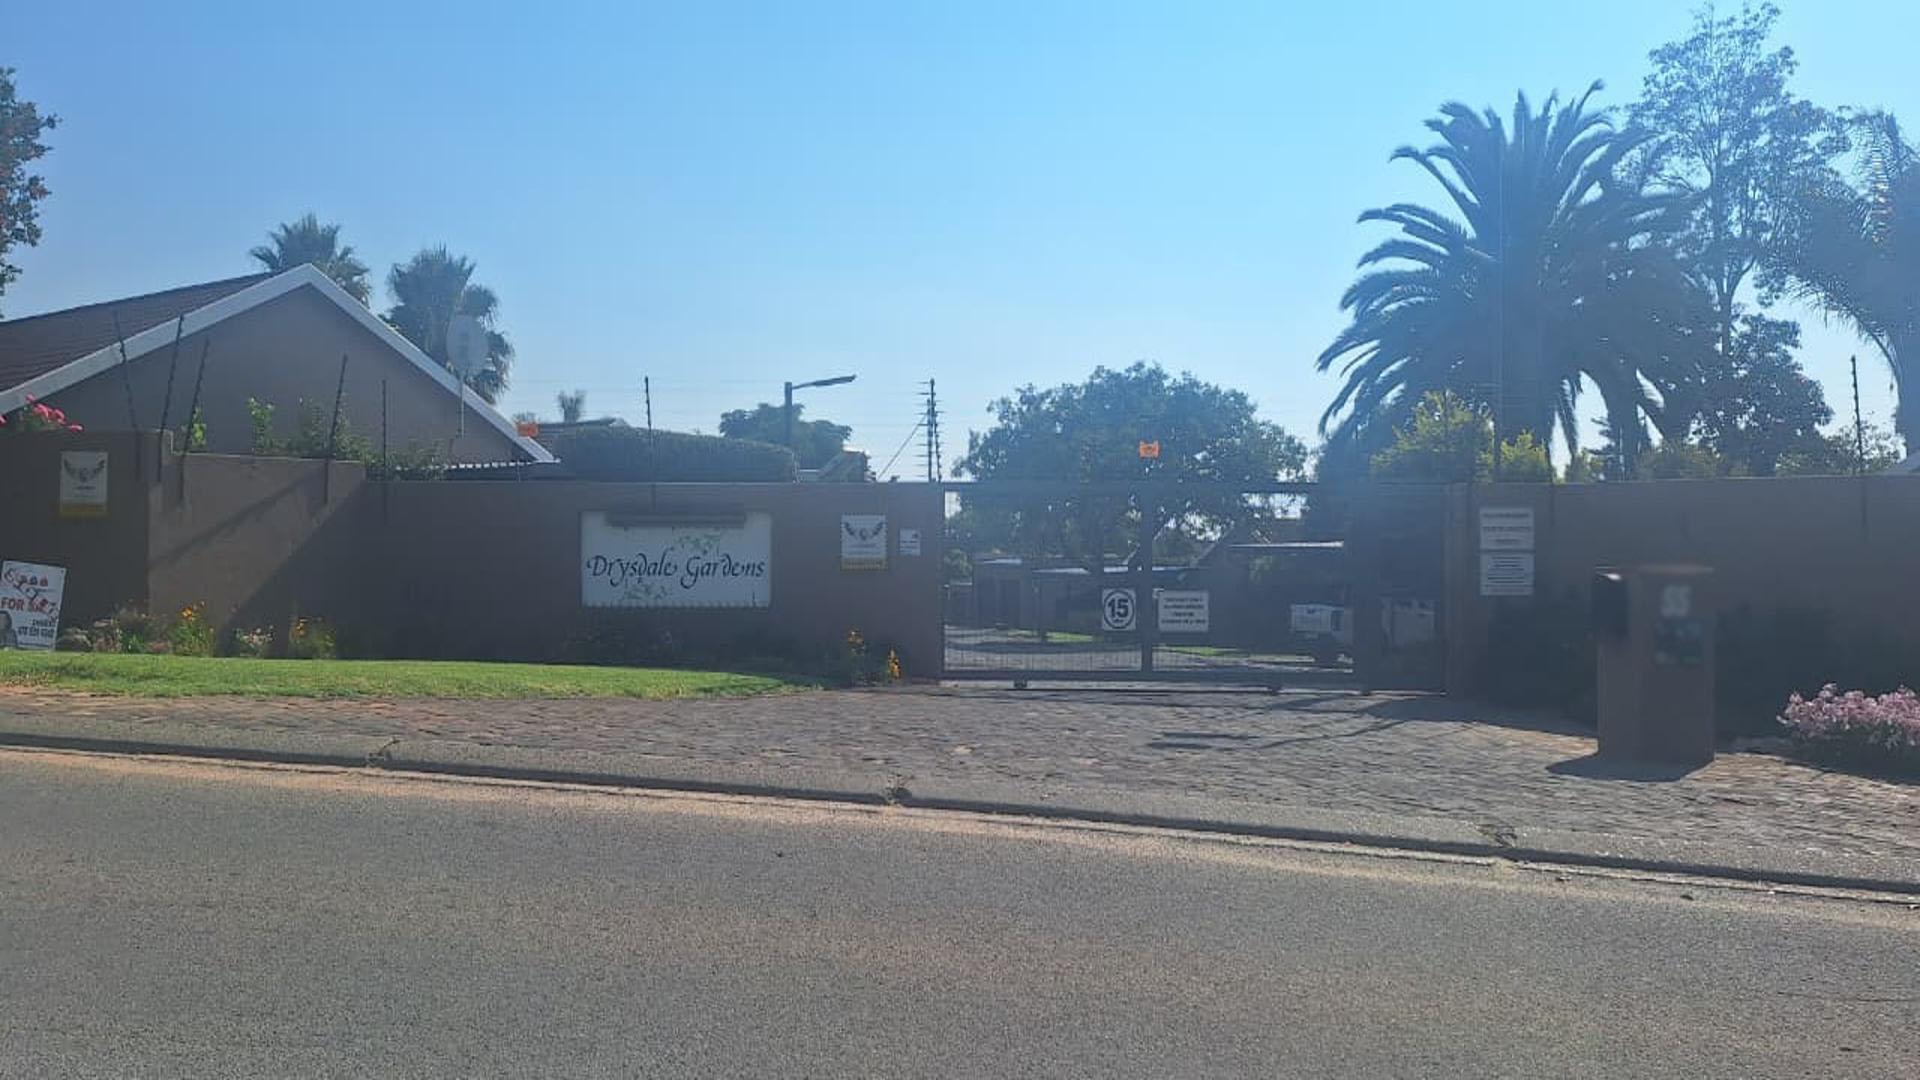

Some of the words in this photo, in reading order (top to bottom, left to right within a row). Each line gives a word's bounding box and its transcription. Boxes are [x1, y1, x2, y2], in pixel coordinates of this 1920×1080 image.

[587, 547, 677, 587] Drysdale
[680, 552, 766, 590] Gardens
[1, 597, 25, 612] FOR
[1107, 597, 1129, 618] 15
